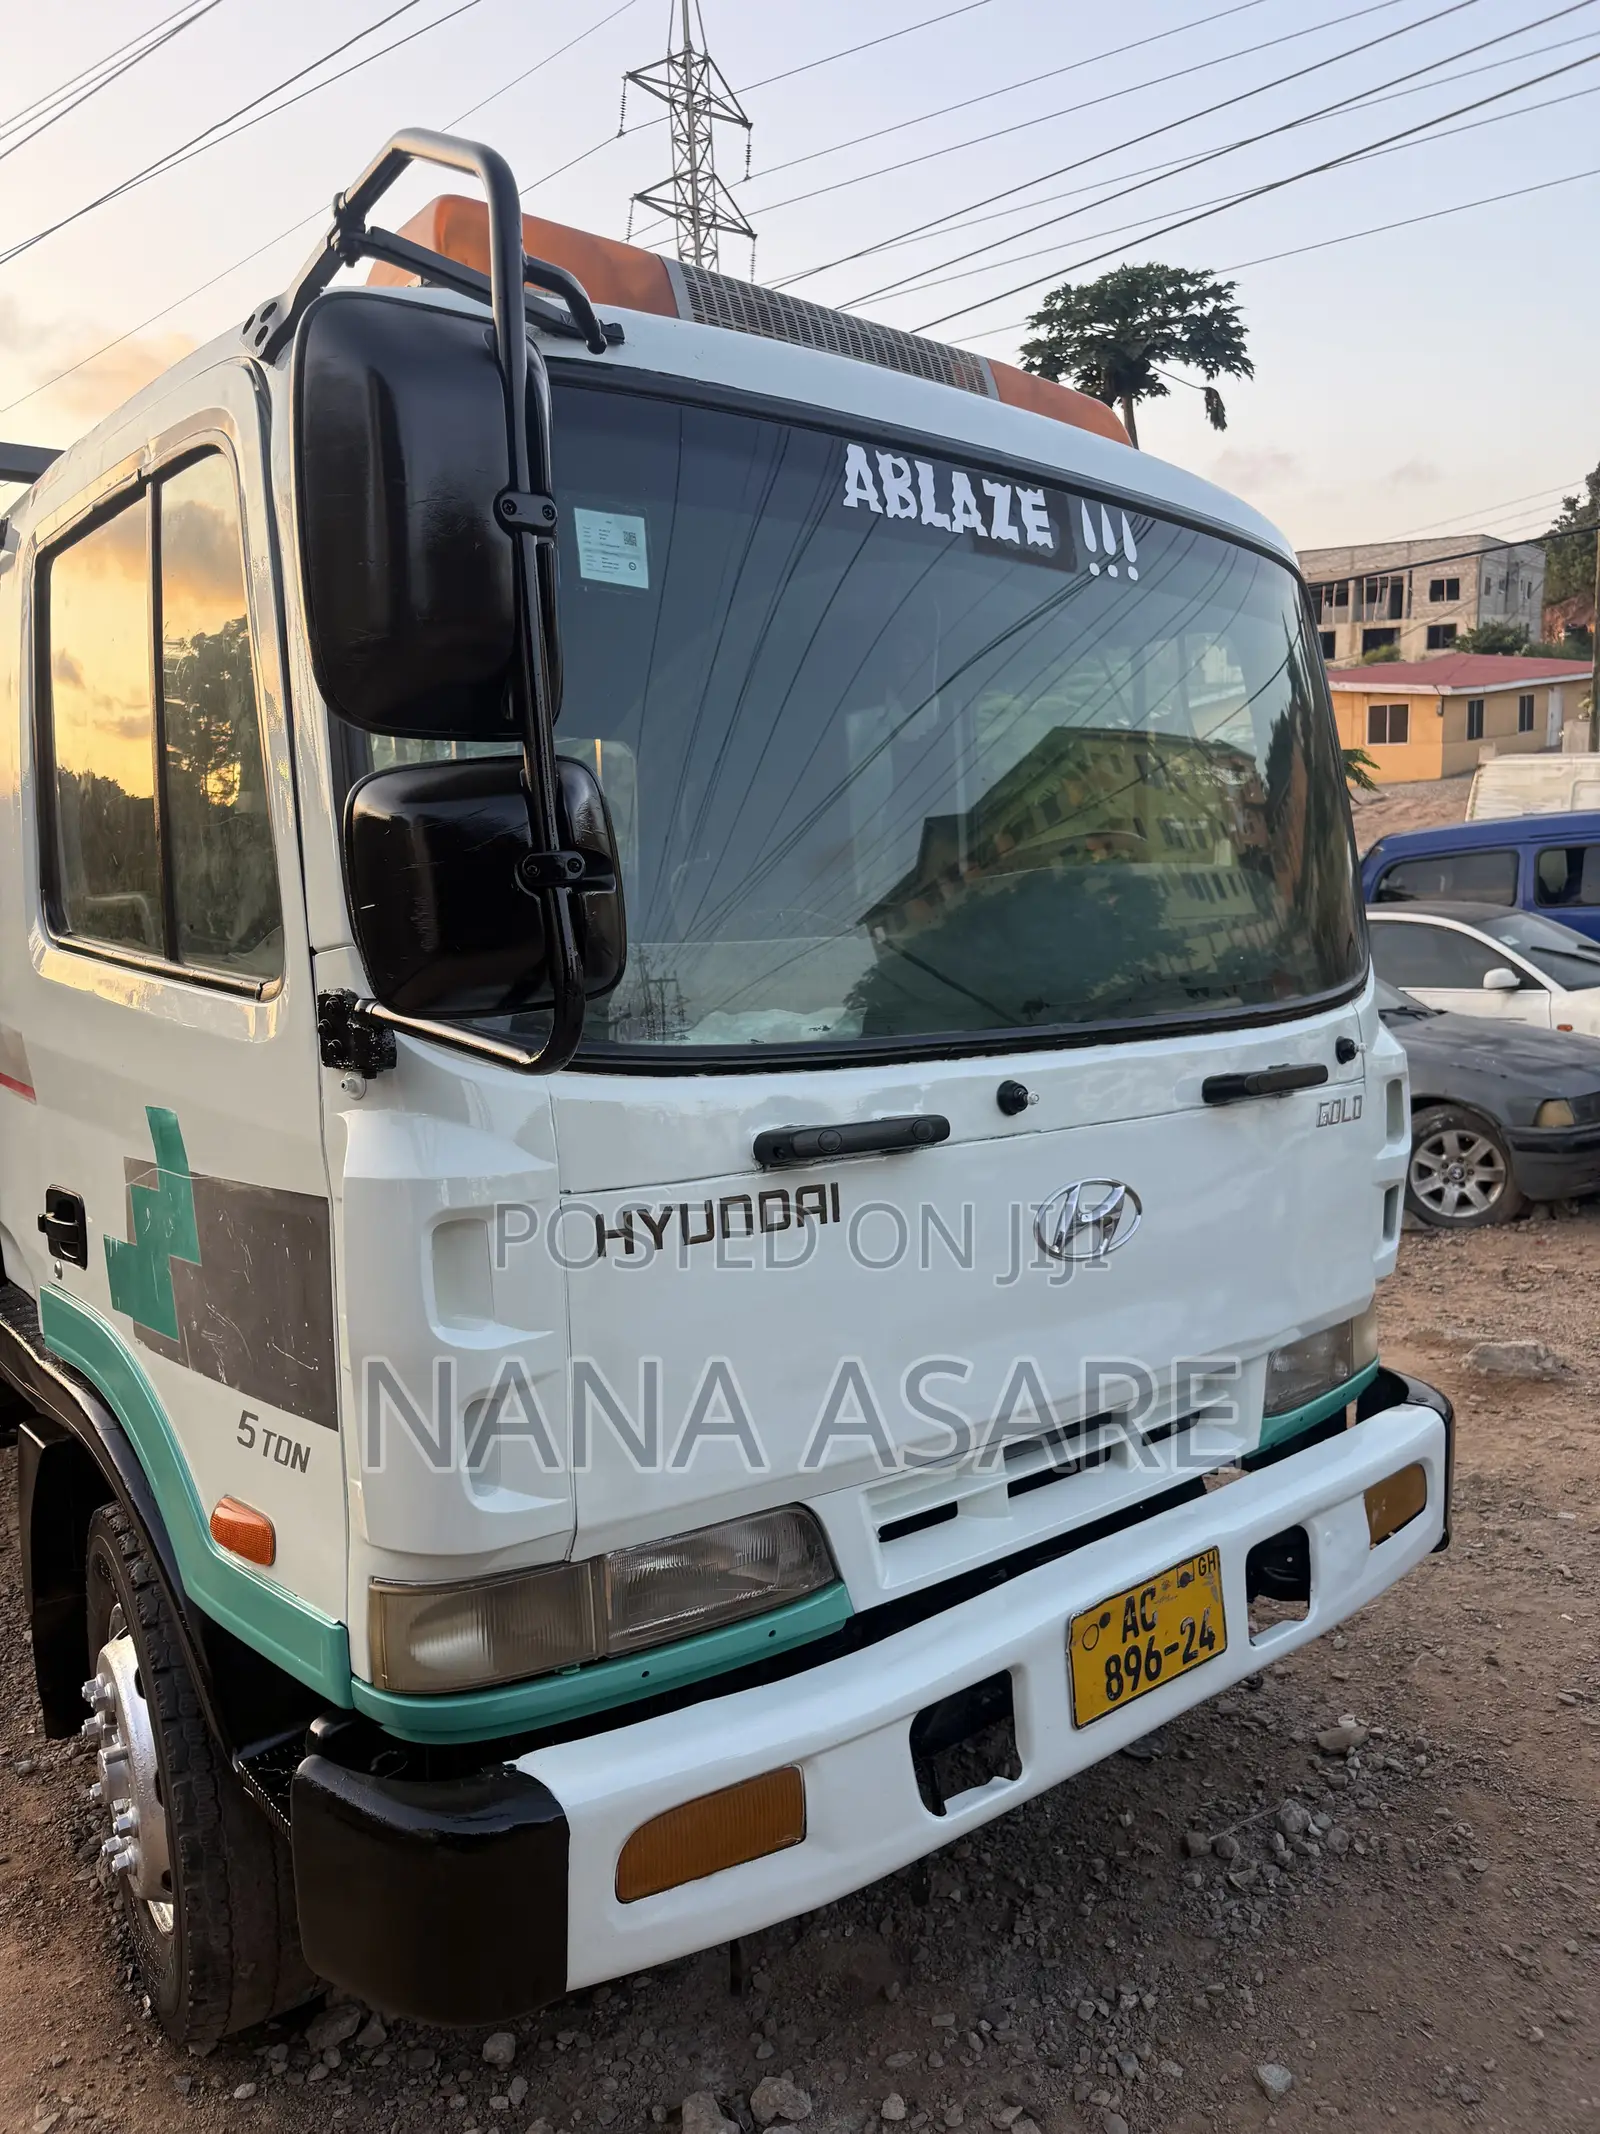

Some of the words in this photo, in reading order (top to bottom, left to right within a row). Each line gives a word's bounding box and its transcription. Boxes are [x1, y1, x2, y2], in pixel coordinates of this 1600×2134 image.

[843, 443, 1054, 549] ABLAZE
[1316, 1095, 1362, 1128] GOLD
[595, 1182, 840, 1258] HYUNDAI
[236, 1409, 259, 1449] 5
[262, 1428, 311, 1474] TON
[1198, 1551, 1216, 1577] GH
[1122, 1585, 1158, 1644] AC
[1104, 1605, 1216, 1701] 896-24
